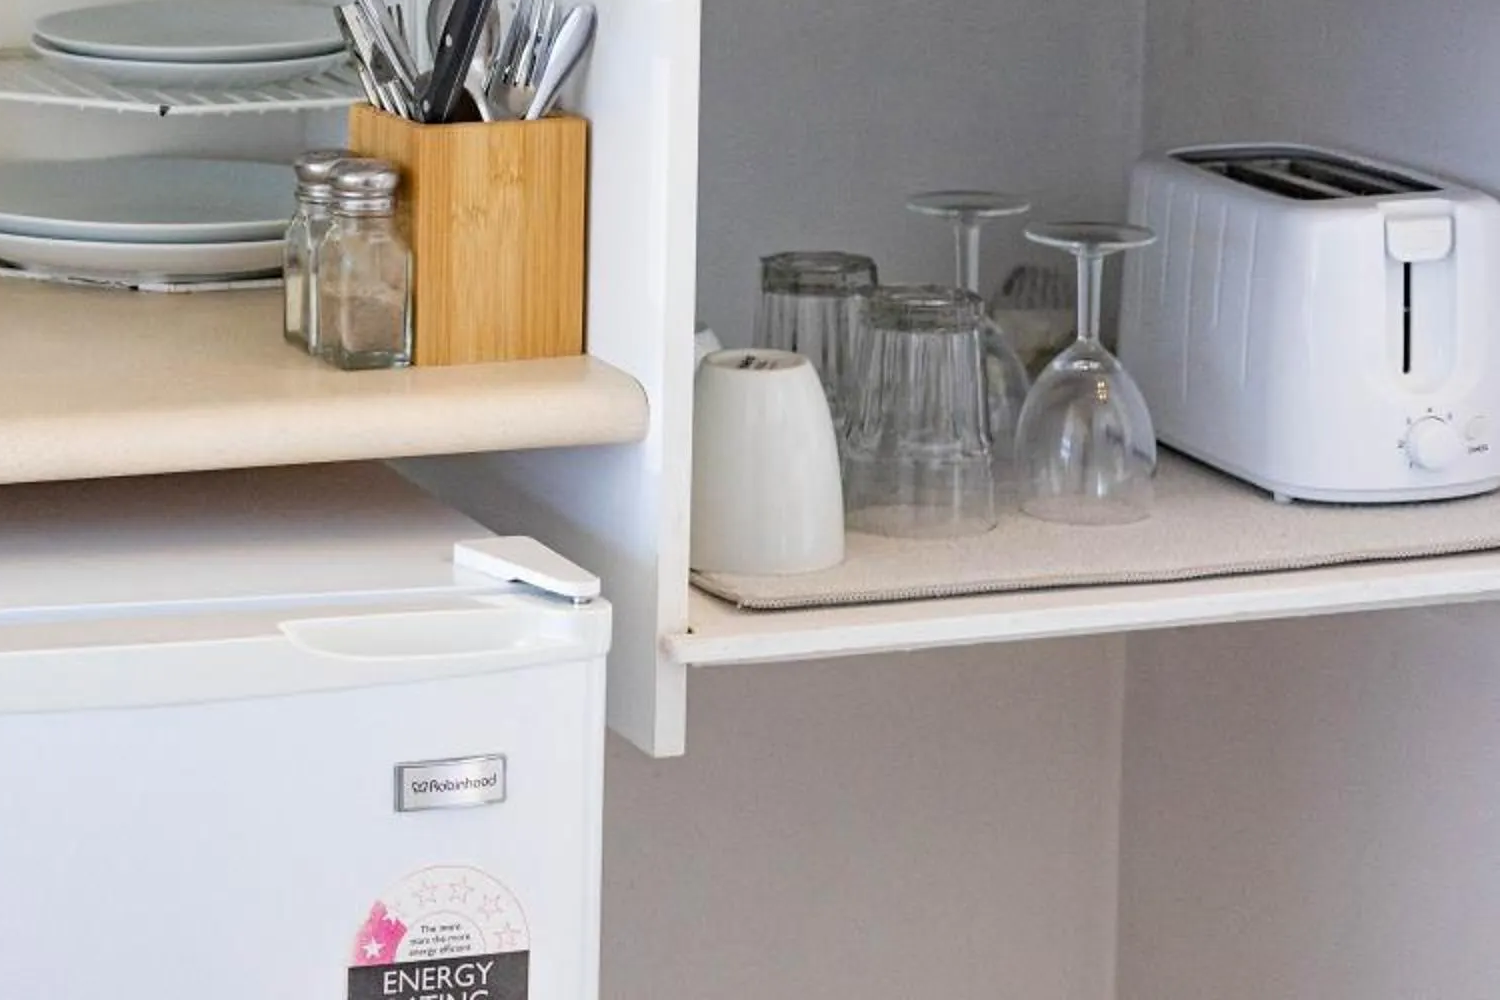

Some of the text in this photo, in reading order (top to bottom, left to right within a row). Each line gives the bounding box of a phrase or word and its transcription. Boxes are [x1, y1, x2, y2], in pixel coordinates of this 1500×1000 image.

[429, 772, 497, 793] Robinhood
[420, 924, 437, 934] The
[383, 961, 494, 995] ENERGY
